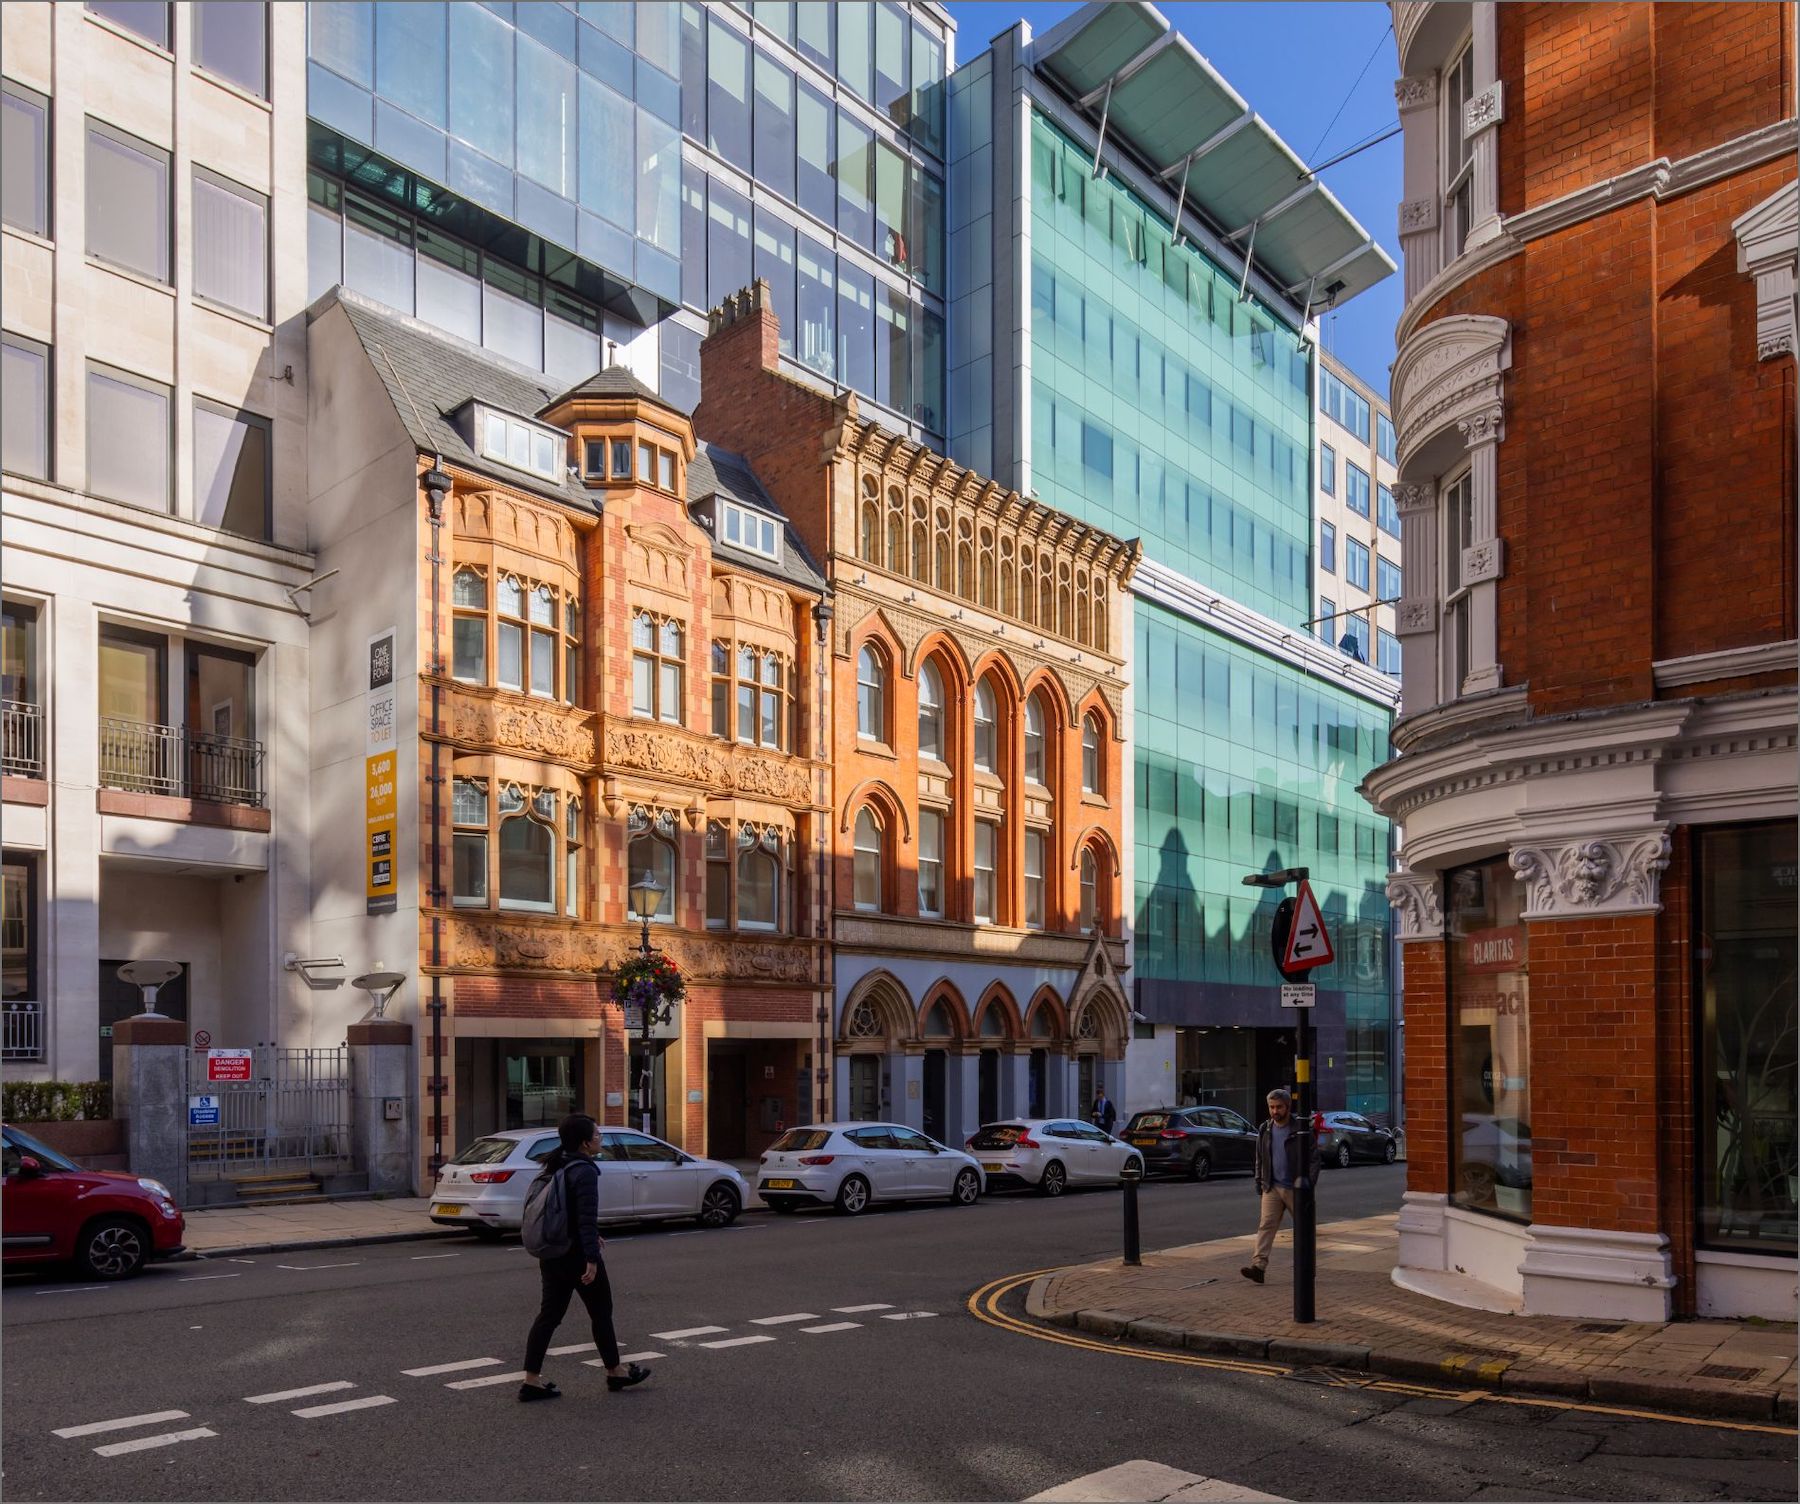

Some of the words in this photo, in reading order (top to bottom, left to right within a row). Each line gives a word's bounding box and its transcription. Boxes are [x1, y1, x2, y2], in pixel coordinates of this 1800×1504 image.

[375, 644, 388, 659] ONE
[373, 654, 390, 669] THREE
[373, 665, 390, 680] FOUR
[370, 698, 392, 717] OFFICE
[371, 712, 392, 730] SPACE
[371, 731, 380, 744] TO
[381, 727, 391, 741] LET
[373, 833, 387, 844] CBRE
[1473, 938, 1514, 965] CLARITAS
